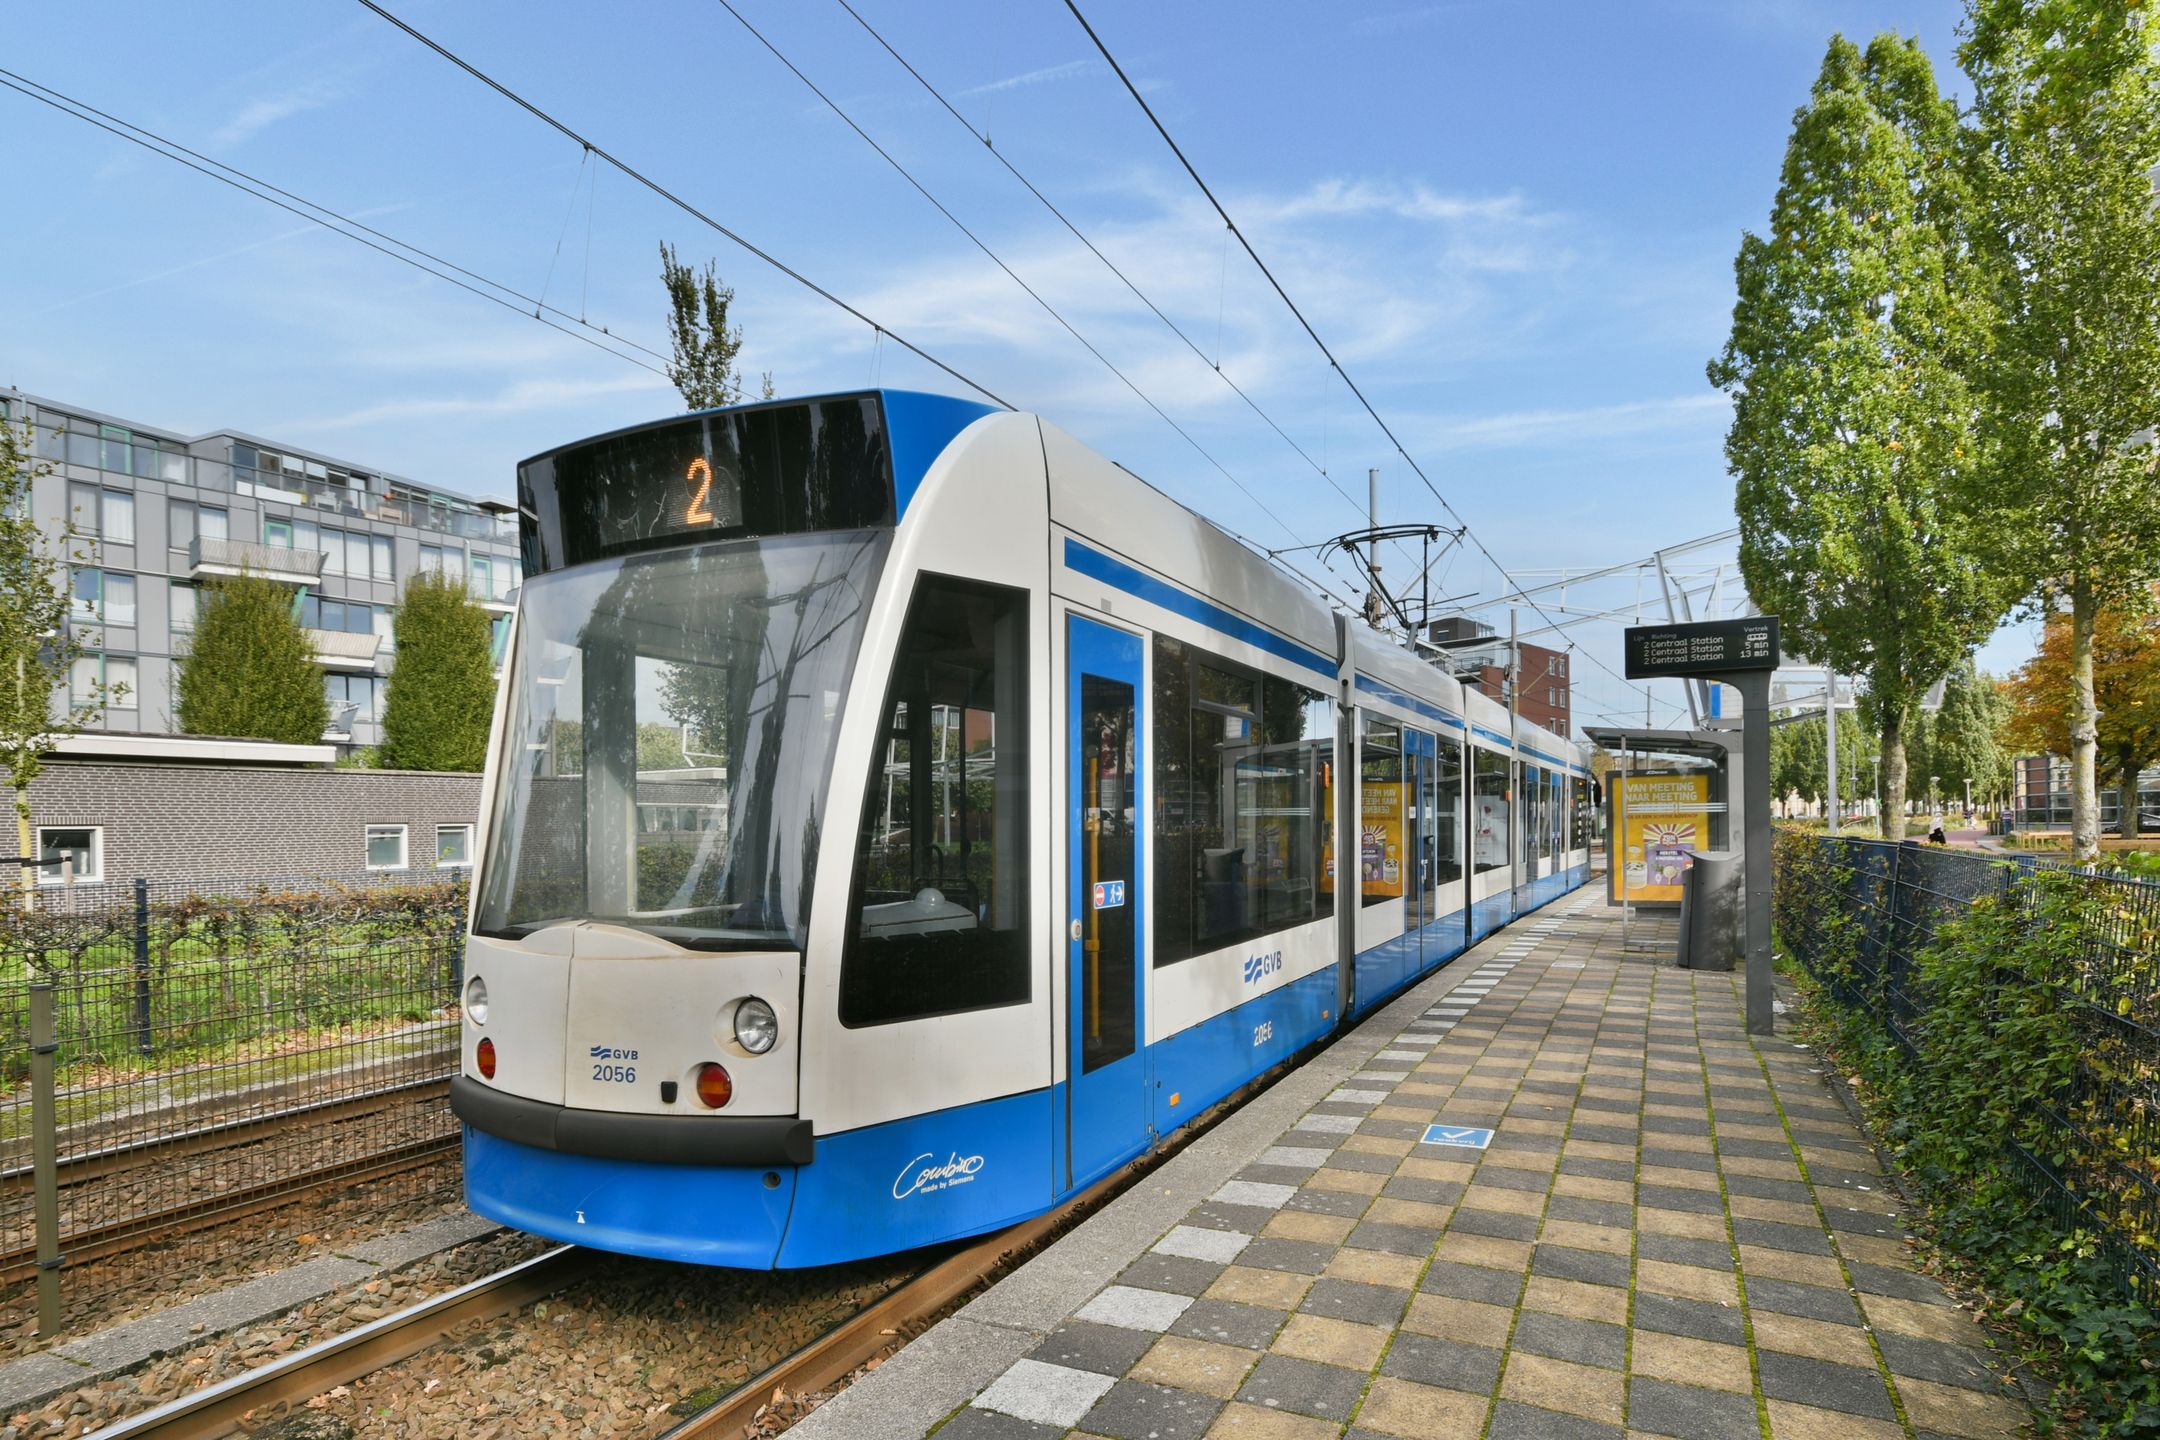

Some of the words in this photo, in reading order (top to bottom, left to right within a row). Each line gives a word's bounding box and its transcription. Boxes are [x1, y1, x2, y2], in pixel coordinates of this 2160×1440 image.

[687, 457, 712, 524] 2
[1643, 641, 1649, 649] 2
[1651, 638, 1688, 648] Centraal
[1691, 636, 1724, 645] Station
[1643, 649, 1649, 657] 2
[1651, 647, 1688, 656] Centraal
[1691, 645, 1724, 654] Station
[1744, 641, 1751, 649] 5
[1754, 640, 1769, 649] min
[1643, 657, 1649, 665] 2
[1651, 655, 1688, 664] Centraal
[1691, 653, 1724, 662] Station
[1740, 649, 1751, 658] 13
[1754, 649, 1769, 657] min
[1627, 784, 1646, 793] VAN
[1650, 782, 1694, 792] MEETING
[1626, 792, 1650, 802] NAAR
[1653, 791, 1697, 801] MEETING
[1263, 951, 1282, 975] GVB
[613, 1049, 638, 1060] GVB
[592, 1064, 636, 1083] 2056
[920, 1184, 938, 1194] made
[939, 1181, 947, 1190] by
[948, 1175, 975, 1187] Siemens
